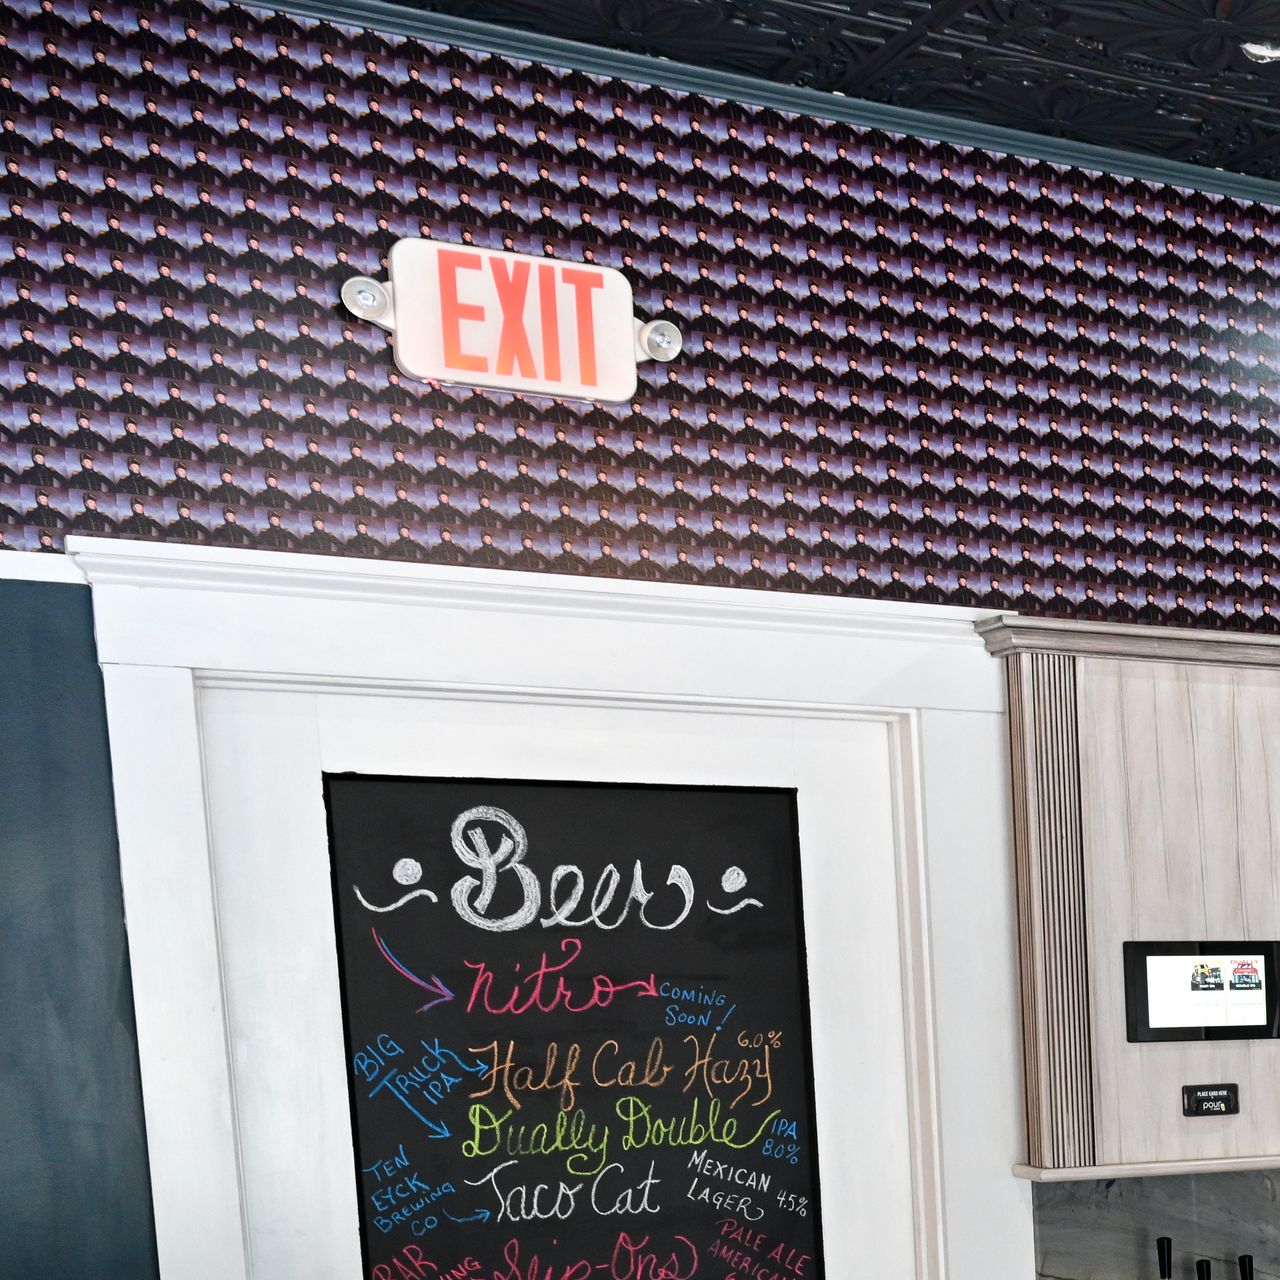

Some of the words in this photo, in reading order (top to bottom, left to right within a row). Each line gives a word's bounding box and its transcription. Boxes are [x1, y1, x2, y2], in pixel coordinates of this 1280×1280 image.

[436, 248, 604, 388] EXIT
[450, 805, 695, 932] Beer
[353, 1033, 406, 1082] BIG
[369, 1038, 448, 1100] TRUCK
[467, 1040, 583, 1112] Half
[592, 1036, 675, 1088] Cab
[683, 1032, 773, 1110] Hazy
[422, 1072, 463, 1105] IPA
[461, 1103, 609, 1177] Dually
[616, 1095, 782, 1151] Double
[770, 1117, 799, 1140] IPA
[362, 1143, 411, 1182] TEN
[687, 1149, 772, 1193] MEXICAN
[370, 1171, 430, 1212] EYCK
[373, 1181, 457, 1234] BREWING
[463, 1159, 585, 1223] Taco
[590, 1159, 662, 1216] Cat
[686, 1177, 765, 1221] LAGER
[410, 1215, 439, 1237] CO
[715, 1217, 768, 1252] PALE
[767, 1242, 813, 1277] ALE
